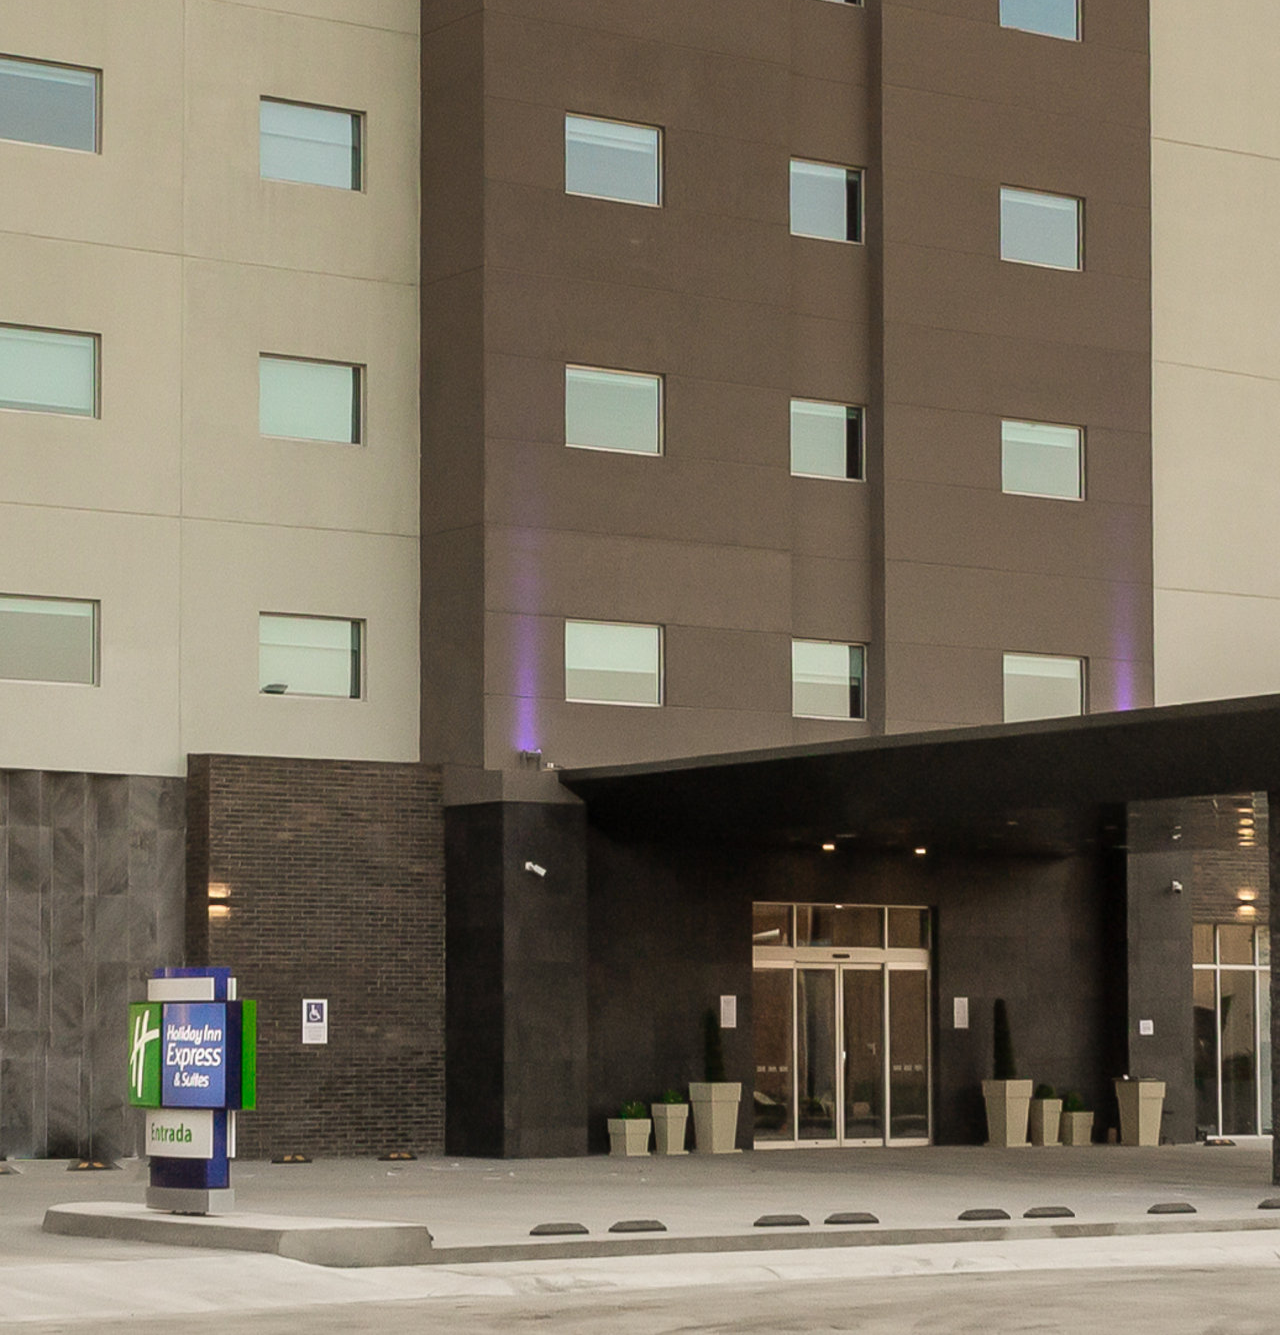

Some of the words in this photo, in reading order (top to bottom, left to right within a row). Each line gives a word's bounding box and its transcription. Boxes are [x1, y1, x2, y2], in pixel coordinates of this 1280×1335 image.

[166, 1024, 203, 1045] Holiday
[203, 1024, 222, 1041] Inn
[166, 1042, 223, 1071] Express
[173, 1072, 181, 1087] &
[181, 1072, 210, 1087] Suites
[151, 1122, 193, 1143] Entrada
